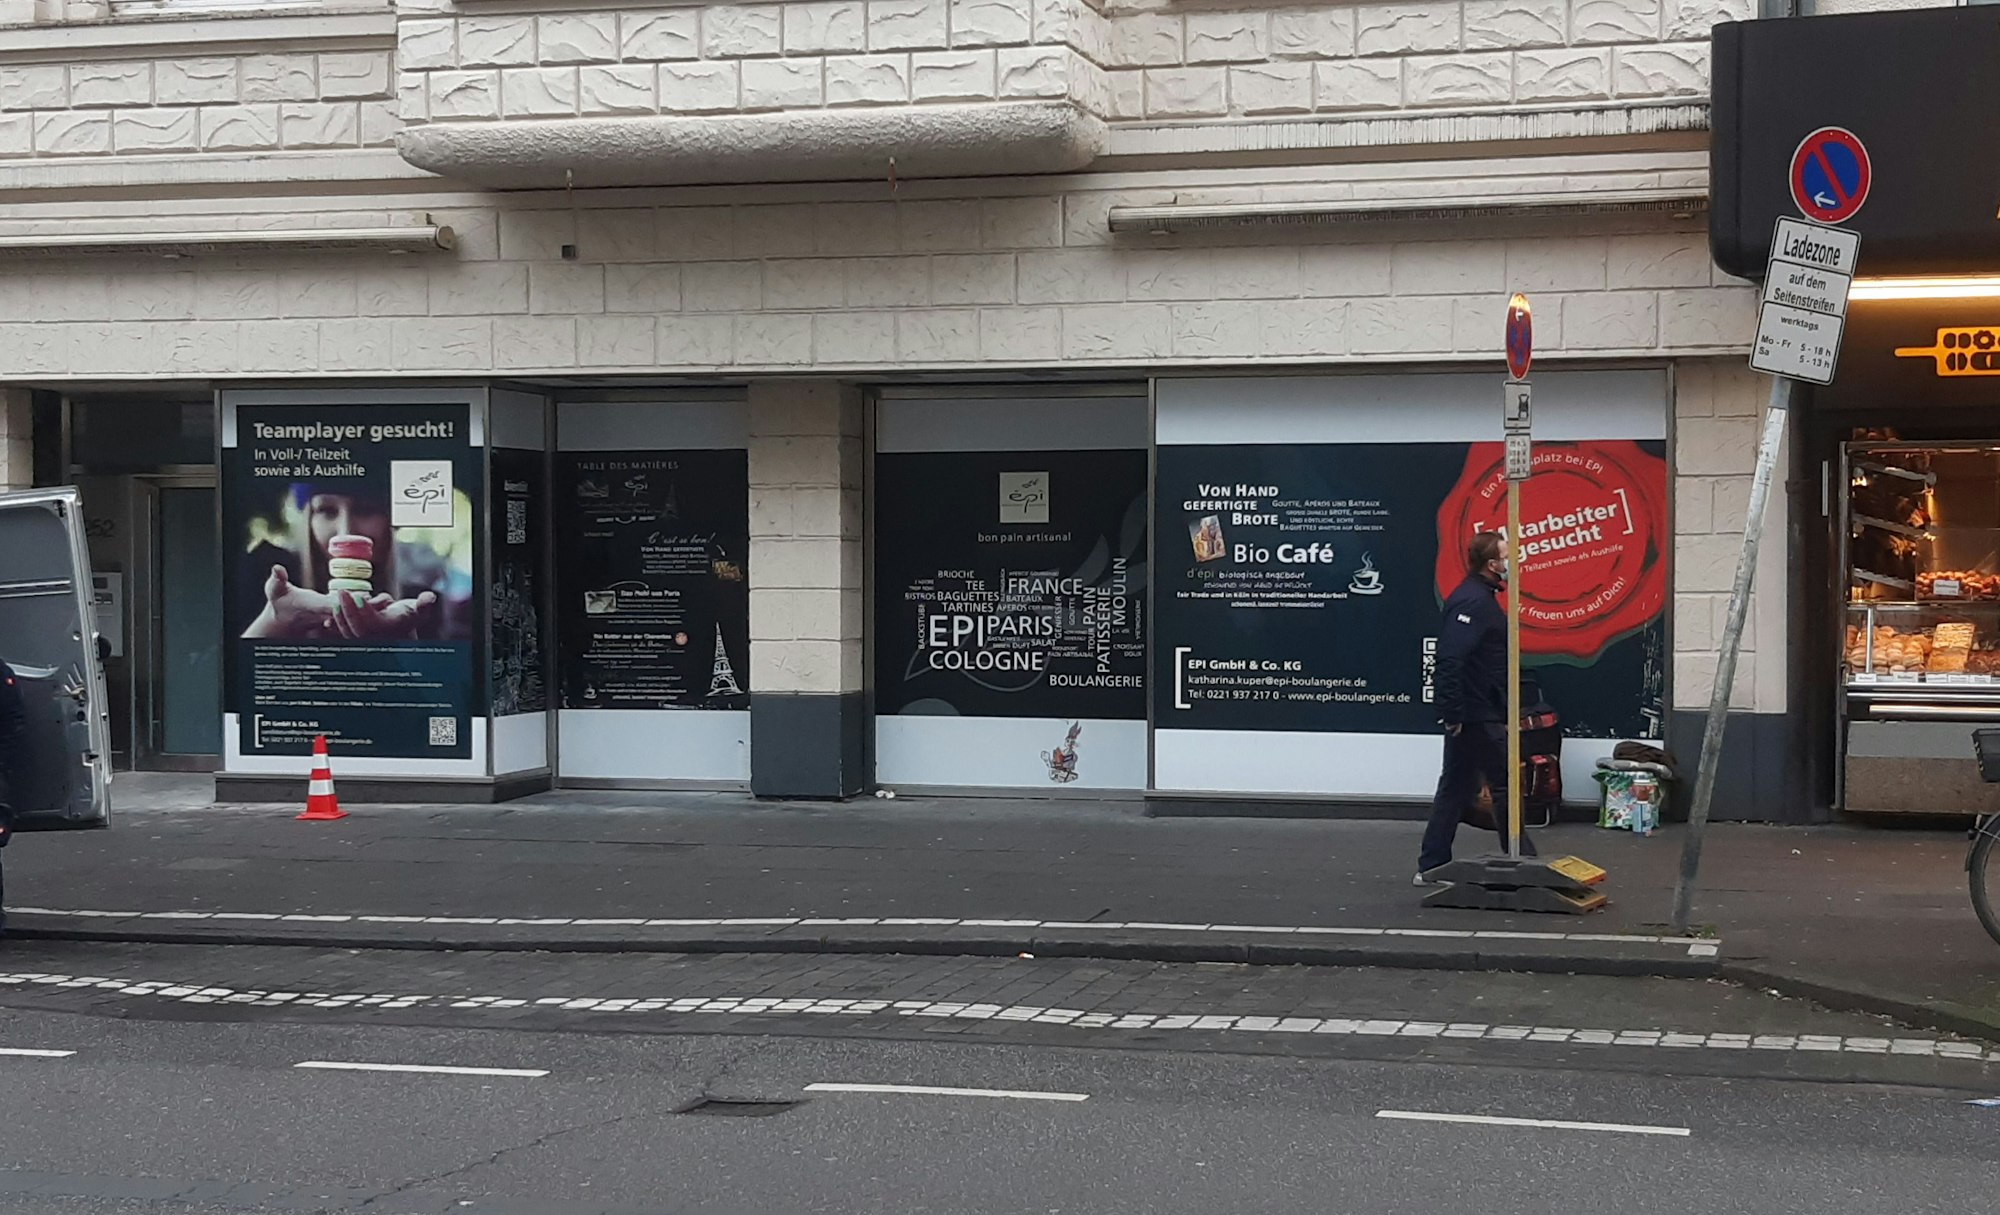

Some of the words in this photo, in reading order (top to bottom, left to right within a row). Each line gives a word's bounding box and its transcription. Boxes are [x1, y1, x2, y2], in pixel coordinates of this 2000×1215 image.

[1783, 230, 1841, 266] Ladezone
[1789, 272, 1805, 285] auf
[1806, 275, 1826, 291] dem
[1773, 287, 1836, 313] Seitenstreifen
[1780, 315, 1819, 331] werktags
[1761, 334, 1774, 345] Mo
[1781, 339, 1792, 349] Fr
[1814, 346, 1824, 355] 18
[1758, 346, 1770, 356] Sa
[1812, 358, 1822, 367] 13
[254, 421, 365, 443] Teamplayer
[370, 421, 454, 443] gesucht!
[254, 449, 267, 461] In
[270, 448, 302, 461] Voll-/
[306, 448, 350, 461] Teilzeit
[254, 465, 290, 477] sowie
[294, 465, 311, 476] als
[313, 463, 366, 477] Aushilfe
[577, 462, 606, 470] TABLE
[610, 462, 628, 470] DES
[631, 460, 680, 470] MATIÈRES
[1480, 483, 1498, 498] Ein
[1565, 453, 1584, 466] bei
[1585, 459, 1604, 474] EPI
[1198, 484, 1231, 497] VON
[1235, 484, 1279, 497] HAND
[1183, 500, 1258, 511] GEFERTIGTE
[1232, 512, 1279, 525] BROTE
[978, 532, 998, 542] bon
[1000, 532, 1024, 544] pain
[1026, 532, 1071, 542] artisanal
[1234, 543, 1270, 563] Bio
[1276, 542, 1334, 564] Café
[1554, 555, 1577, 566] sowie
[1591, 543, 1624, 557] Aushilfe
[937, 570, 975, 579] BRIOCHE
[1219, 570, 1263, 581] biologisch
[1264, 571, 1305, 581] angebaut
[965, 580, 985, 591] TEE
[1008, 578, 1083, 595] FRANCE
[1113, 557, 1126, 626] MOULIN
[937, 591, 1000, 602] BAGUETTES
[1006, 594, 1043, 603] BATEAUX
[1528, 606, 1563, 620] freuen
[1566, 607, 1585, 619] uns
[1587, 596, 1604, 612] auf
[1602, 576, 1626, 601] Dich!
[941, 602, 994, 613] TARTINES
[1083, 587, 1096, 625] PAIN
[918, 603, 926, 650] BACKSTUBE
[929, 615, 984, 648] EPI
[987, 615, 1054, 636] PARIS
[1097, 587, 1111, 673] PATISSERIE
[1031, 638, 1057, 647] SALAT
[929, 650, 1043, 670] COLOGNE
[1188, 659, 1206, 669] EPI
[1209, 659, 1246, 670] GmbH
[1249, 660, 1258, 670] &
[1261, 660, 1281, 671] Co.
[1284, 661, 1302, 671] KG
[1049, 674, 1143, 688] BOULANGERIE
[1207, 689, 1230, 699] 0221
[1232, 690, 1250, 699] 937
[1253, 690, 1271, 700] 217
[1272, 691, 1280, 700] 0
[1288, 691, 1411, 705] www.epi-boulangerie.de
